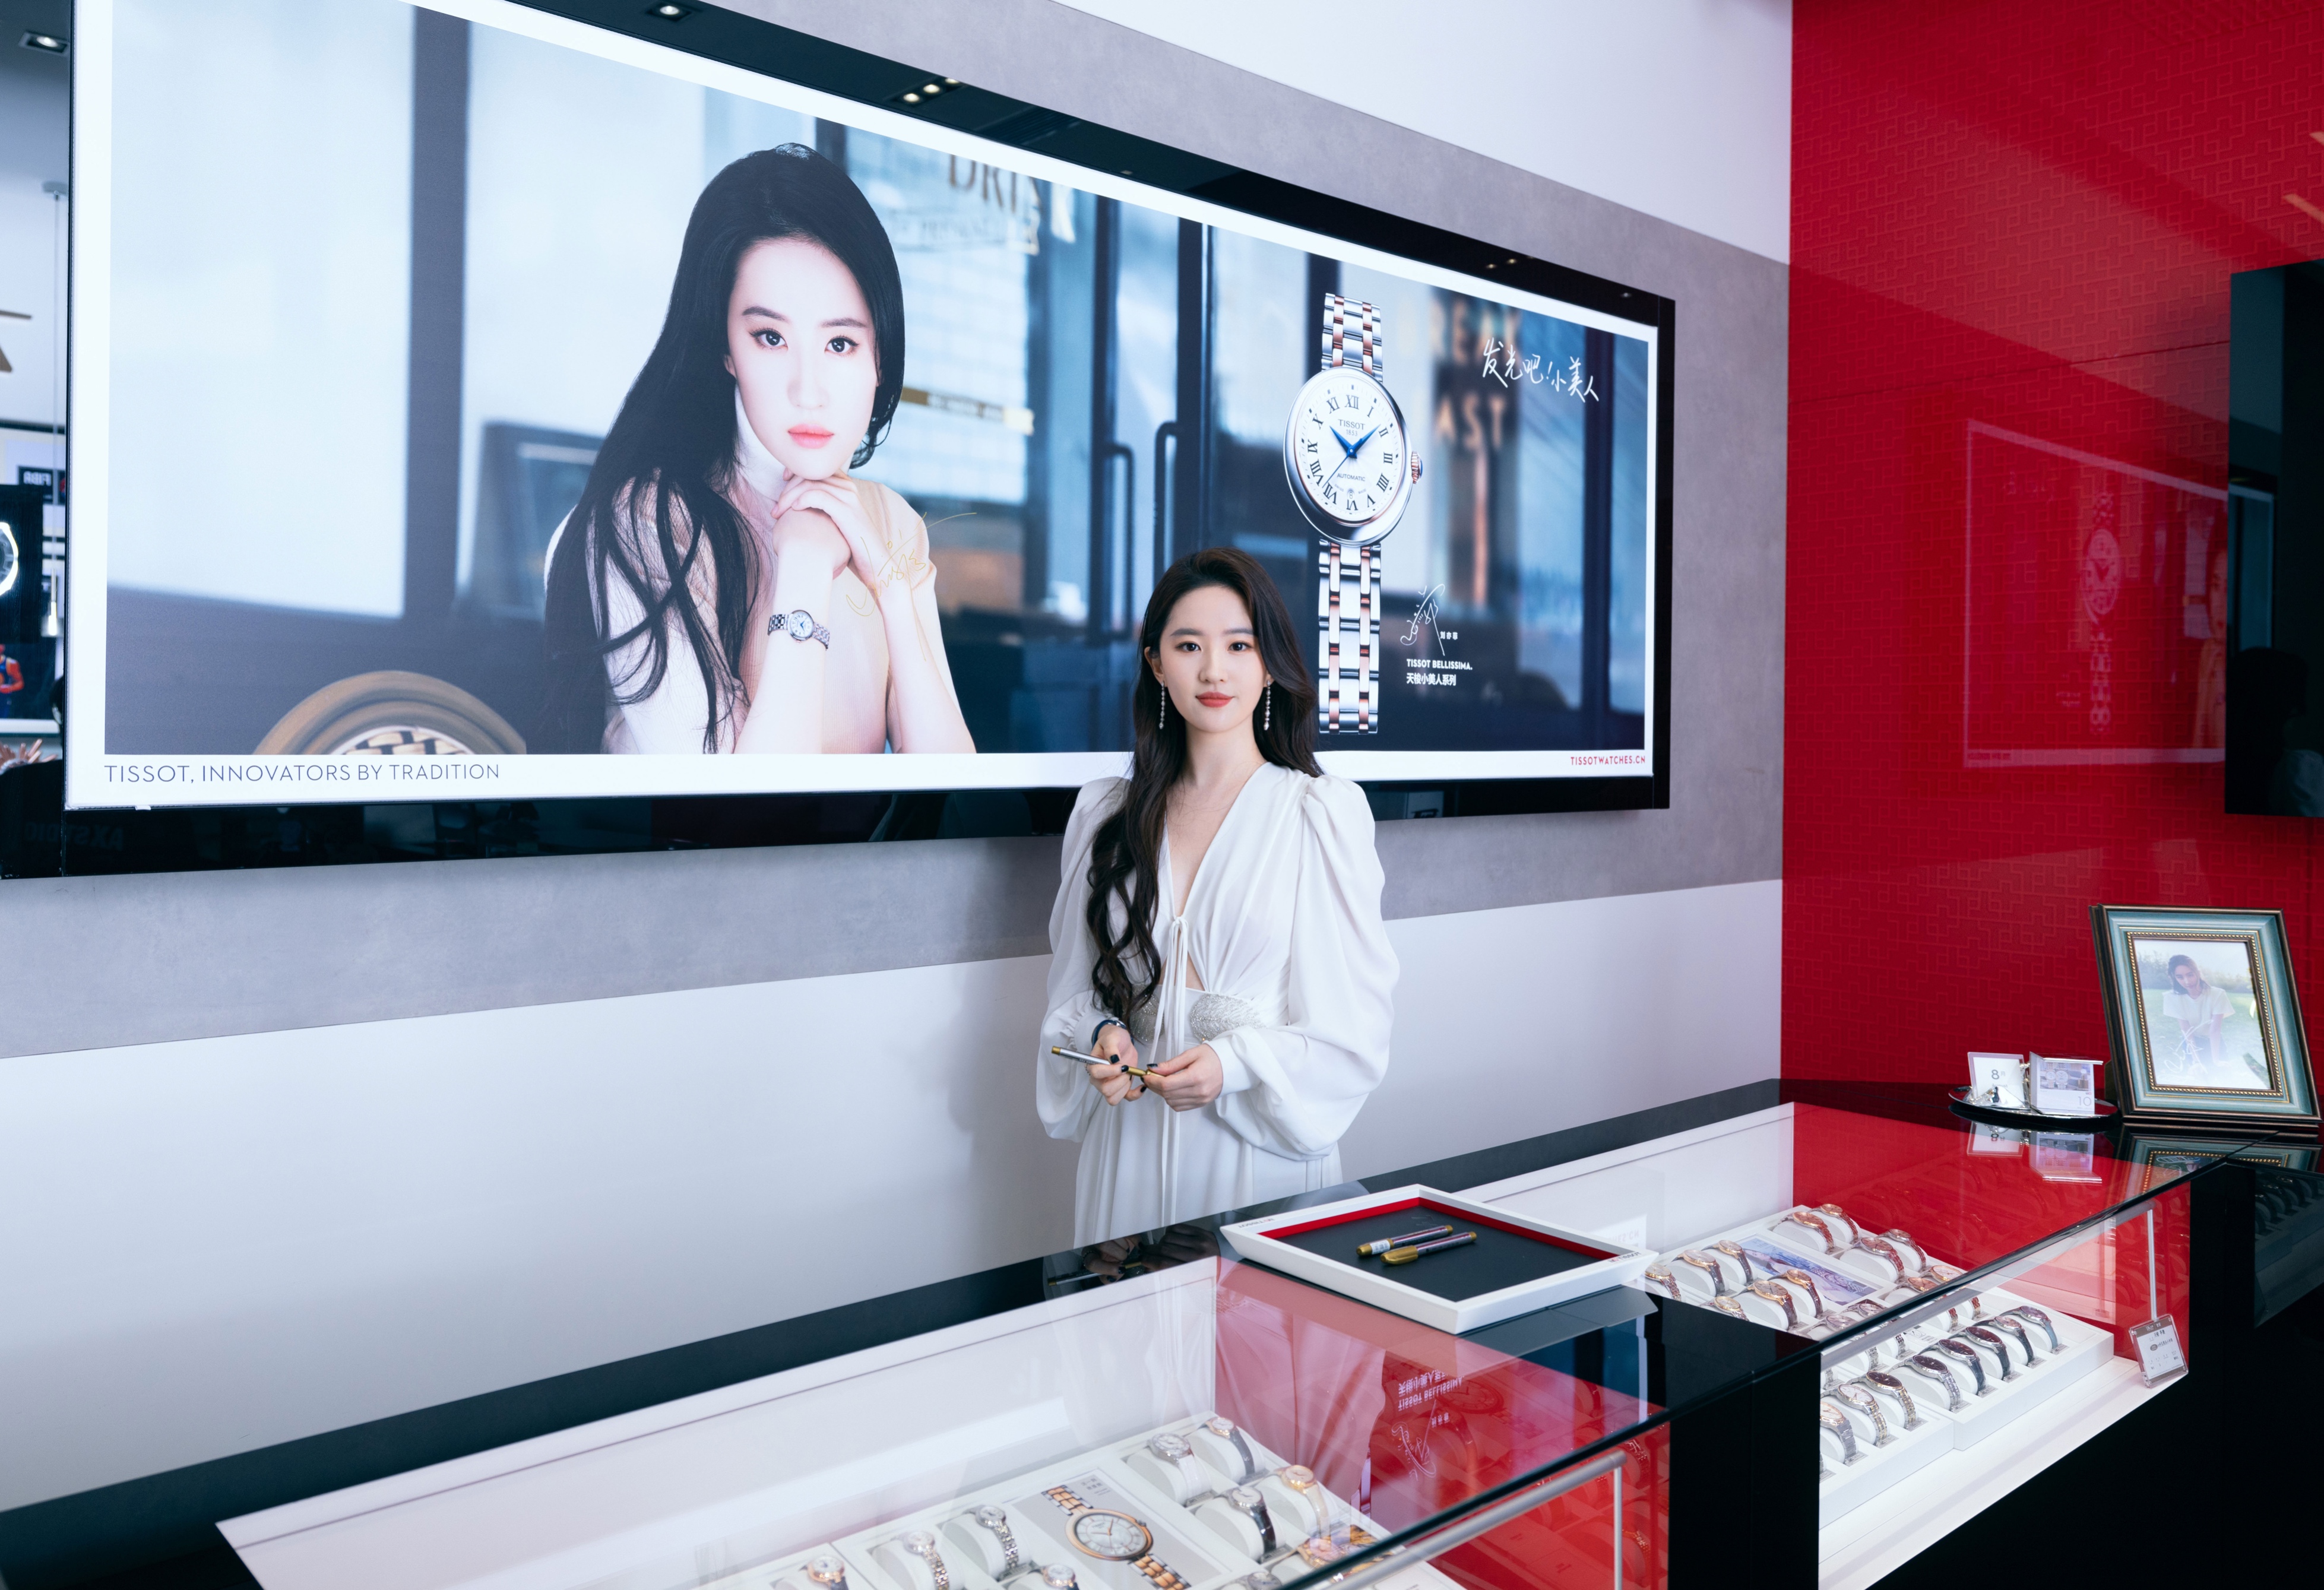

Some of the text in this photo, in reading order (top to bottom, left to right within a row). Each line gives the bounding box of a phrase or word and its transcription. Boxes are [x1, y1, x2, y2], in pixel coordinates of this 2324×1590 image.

[1326, 397, 1340, 414] XI
[1345, 395, 1359, 410] XII
[1312, 413, 1324, 429] X
[1338, 419, 1366, 430] TISSOT
[1379, 427, 1389, 438] II
[1383, 452, 1392, 464] III
[1337, 473, 1366, 482] AUTOMATIC
[1440, 631, 1458, 641] 刘亦菲
[1406, 658, 1473, 671] TISSOT BELLISSIMA.
[1406, 672, 1457, 686] 天梭小美人系列
[1571, 756, 1645, 765] TISSOTWATCHES.CN
[105, 764, 500, 785] TISSOT, INNOVATORS BY TRADITION
[2078, 1096, 2092, 1106] 10
